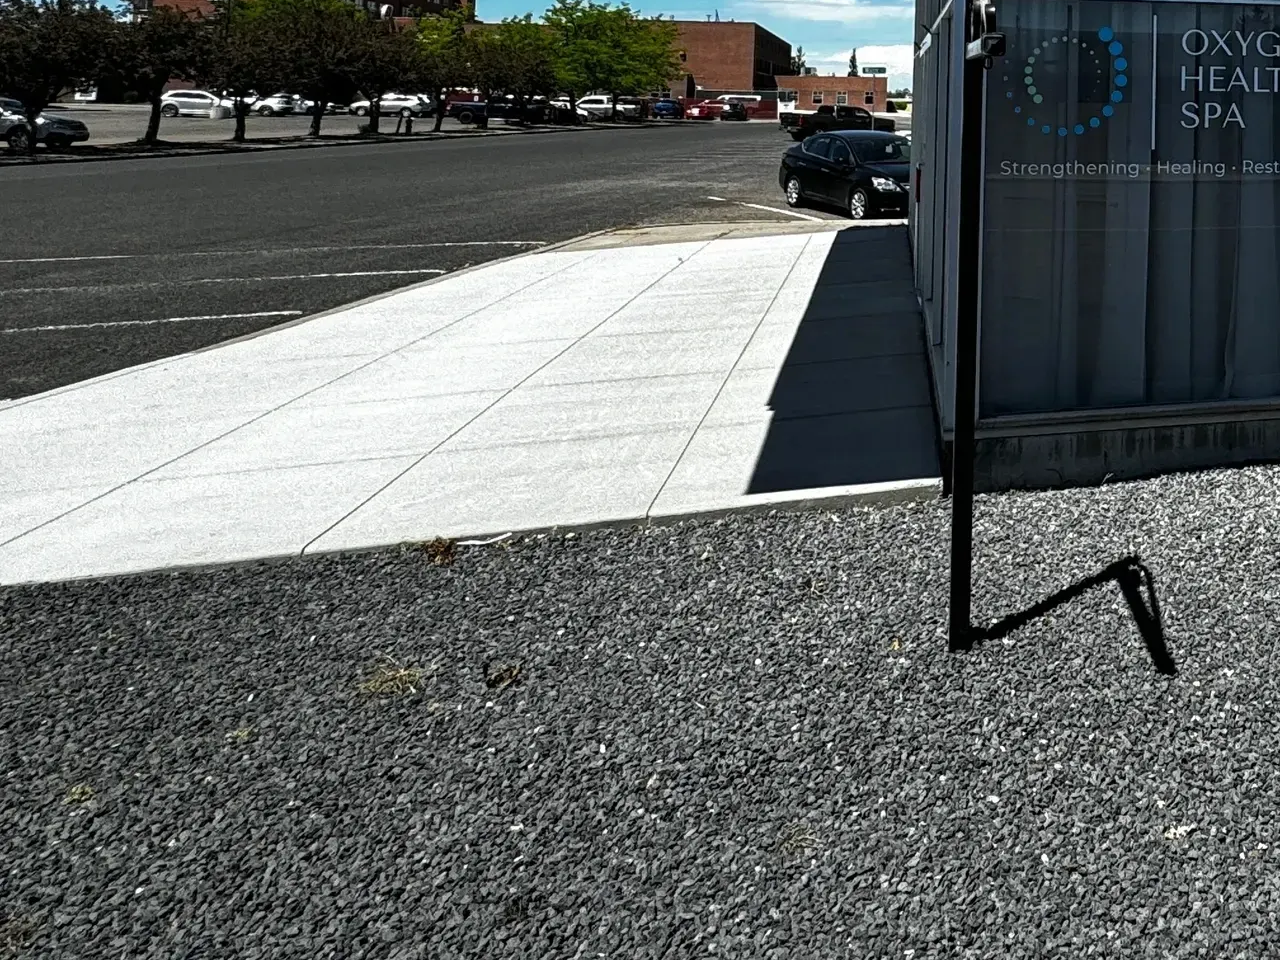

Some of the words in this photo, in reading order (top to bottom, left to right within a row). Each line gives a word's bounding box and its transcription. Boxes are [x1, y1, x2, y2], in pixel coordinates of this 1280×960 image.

[1180, 102, 1246, 129] SPA
[1000, 160, 1140, 178] Strengthening
[1157, 159, 1226, 178] Healing
